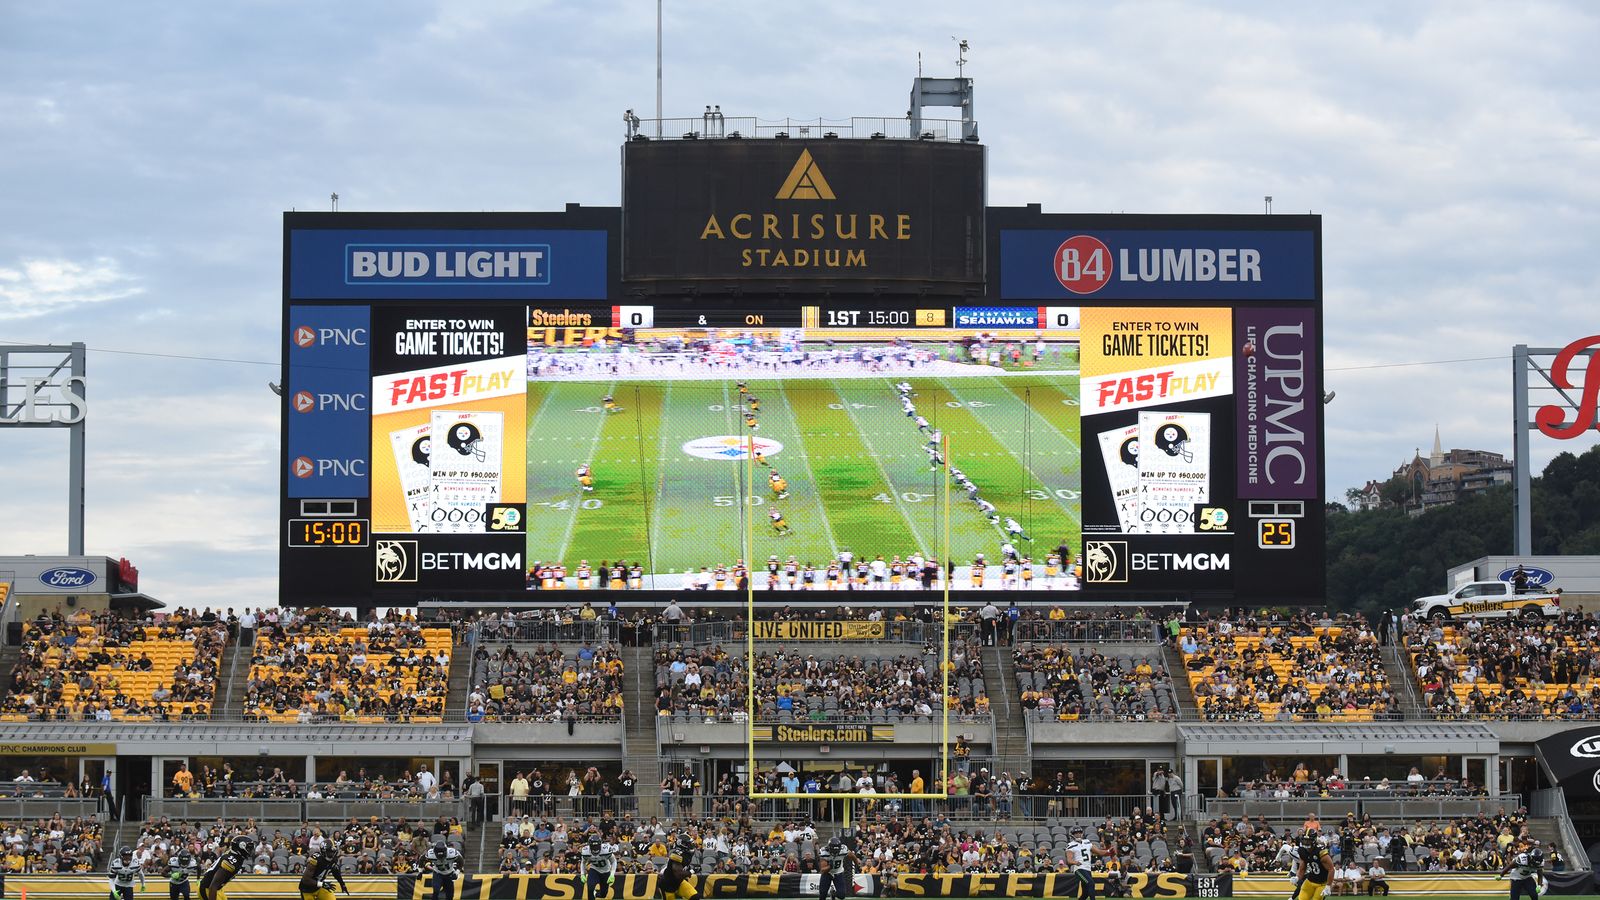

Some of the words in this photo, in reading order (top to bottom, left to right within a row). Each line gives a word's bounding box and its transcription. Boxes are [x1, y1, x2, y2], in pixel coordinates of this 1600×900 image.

[700, 213, 911, 240] ACRISURE
[353, 251, 430, 278] BUD
[435, 251, 543, 278] LIGHT
[742, 249, 867, 267] STADIUM
[1061, 248, 1106, 282] 84
[1119, 248, 1262, 282] LUMBER
[406, 319, 447, 330] ENTER
[449, 319, 466, 330] TO
[468, 319, 494, 330] WIN
[532, 308, 592, 326] Steelers
[631, 312, 643, 326] 0
[698, 315, 707, 325] &
[745, 314, 764, 325] ON
[827, 310, 861, 326] 1ST
[867, 310, 910, 326] 15:00
[926, 312, 934, 323] 8
[959, 316, 1034, 325] SEAHAWKS
[1057, 313, 1069, 327] 0
[1112, 321, 1154, 331] ENTER
[1155, 321, 1172, 331] TO
[1174, 321, 1199, 331] WIN
[318, 328, 367, 346] PNC
[395, 332, 437, 355] GAME
[440, 331, 505, 355] TICKETS!
[1103, 334, 1143, 356] GAME
[1147, 334, 1209, 356] TICKETS!
[1247, 356, 1257, 422] CHANGING
[317, 393, 366, 411] PNC
[1263, 321, 1306, 485] UPMC
[1248, 424, 1258, 484] MEDICINE
[317, 459, 365, 477] PNC
[304, 523, 361, 544] 15:00
[1262, 523, 1291, 545] 25
[421, 552, 521, 570] BETMGM
[1131, 553, 1230, 571] BETMGM
[50, 569, 86, 585] Ford
[1462, 600, 1504, 614] Steelers
[752, 621, 783, 639] LIVE
[788, 621, 843, 639] UNITED
[777, 724, 868, 742] Steelers.com
[181, 776, 189, 784] 90
[623, 779, 632, 787] 43
[682, 779, 691, 789] 44
[800, 832, 812, 841] 75
[296, 847, 303, 855] 7
[1081, 849, 1090, 862] 5
[1197, 877, 1219, 889] EST.
[1198, 888, 1219, 898] 1933
